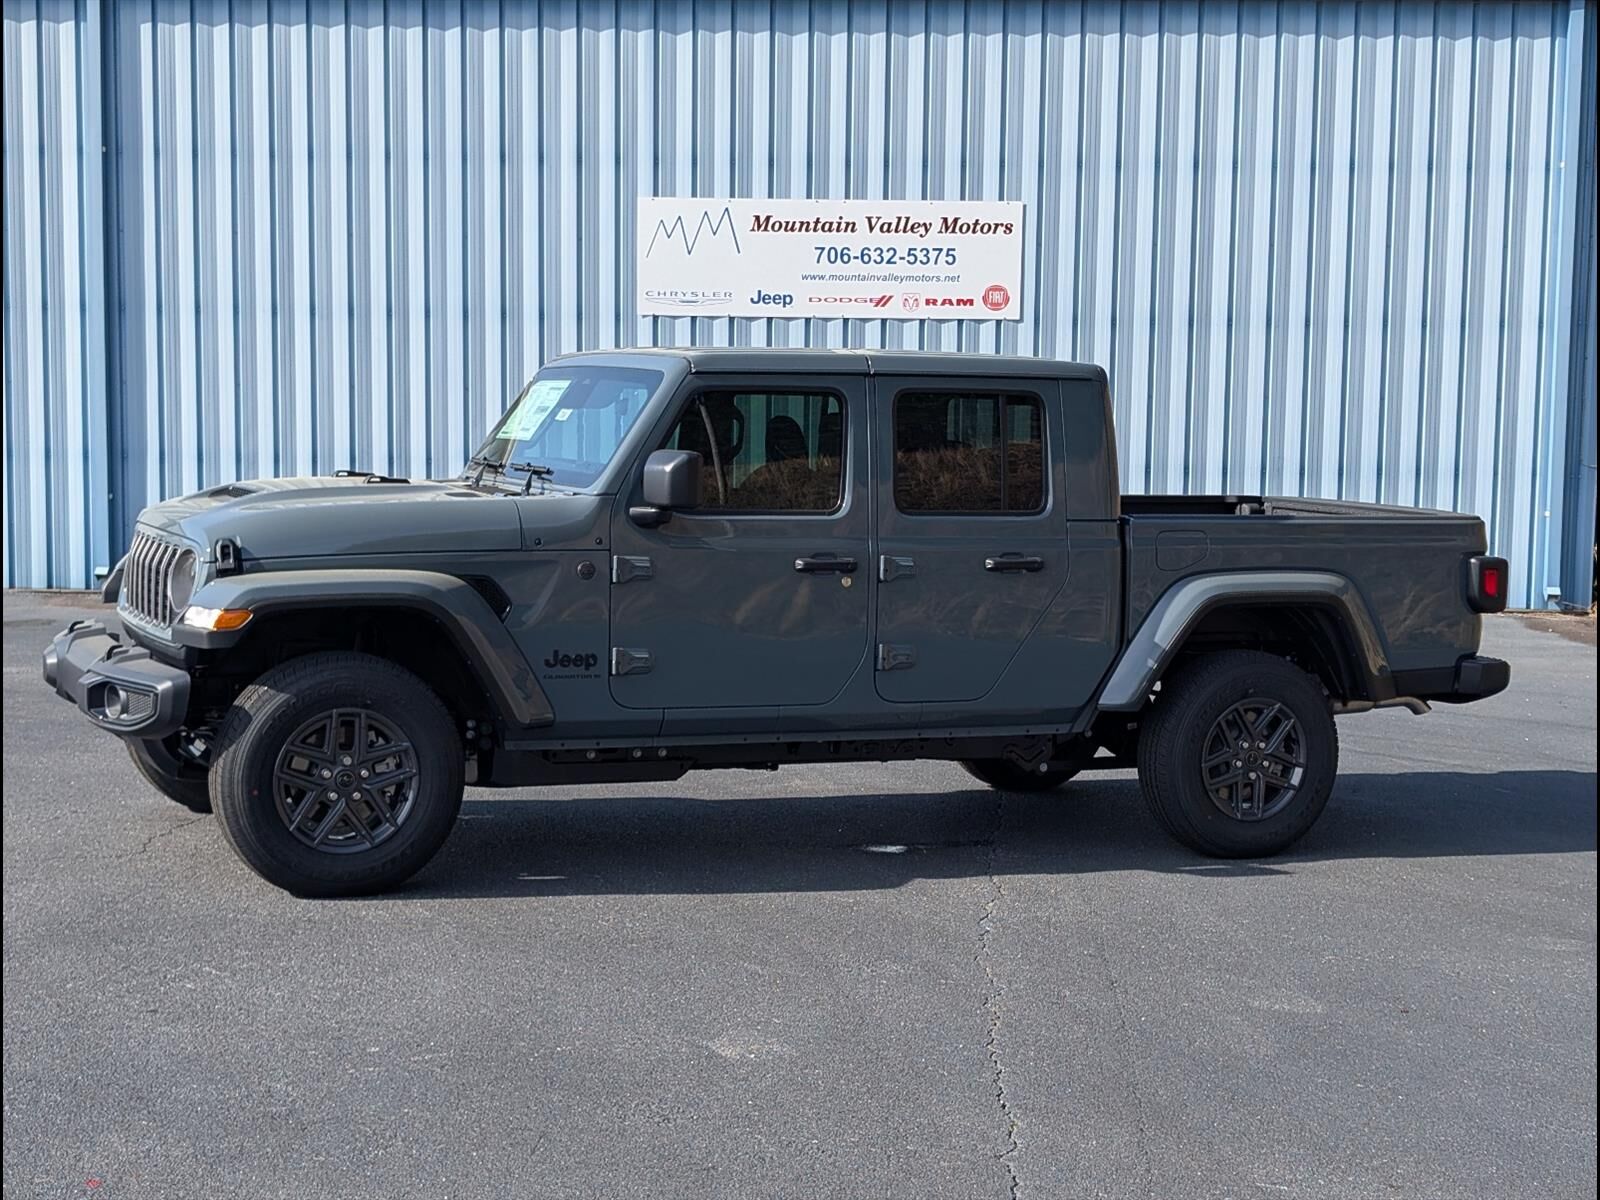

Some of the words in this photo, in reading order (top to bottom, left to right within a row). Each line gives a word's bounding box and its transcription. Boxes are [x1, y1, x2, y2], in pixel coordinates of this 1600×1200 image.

[750, 215, 858, 233] Mountain
[865, 216, 932, 238] Valley
[937, 217, 1014, 235] Motors
[814, 246, 957, 266] 706-632-5375
[801, 272, 961, 285] www.mountainvalleymotors.net
[645, 290, 733, 298] CHRYSLER
[750, 289, 794, 308] Jeep
[925, 298, 974, 307] RAM
[543, 649, 598, 671] Jeep
